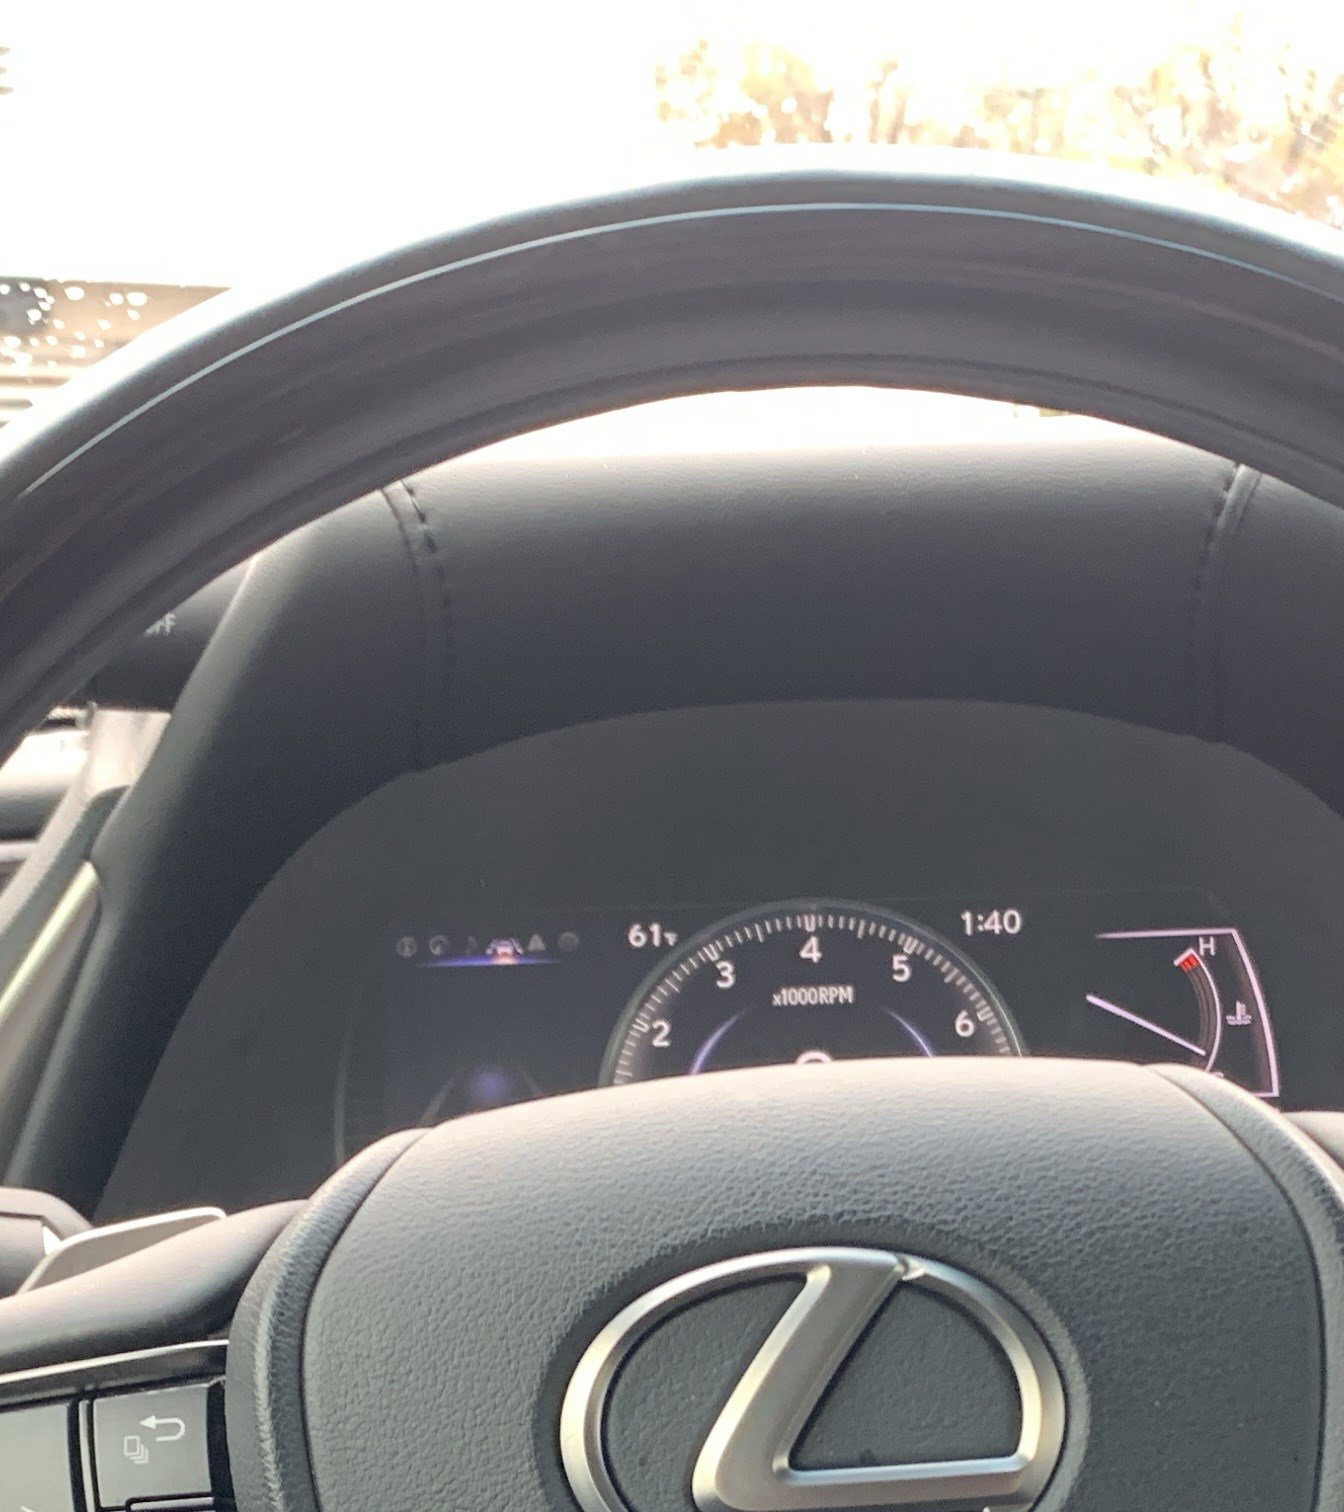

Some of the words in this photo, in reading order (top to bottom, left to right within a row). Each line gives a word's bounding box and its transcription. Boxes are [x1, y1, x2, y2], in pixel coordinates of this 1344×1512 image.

[960, 908, 1023, 936] 1:40
[798, 935, 823, 964] 4
[1198, 936, 1216, 957] H
[715, 960, 737, 989] 3
[891, 953, 912, 983] 5
[651, 1018, 672, 1048] 2
[954, 1009, 976, 1039] 6
